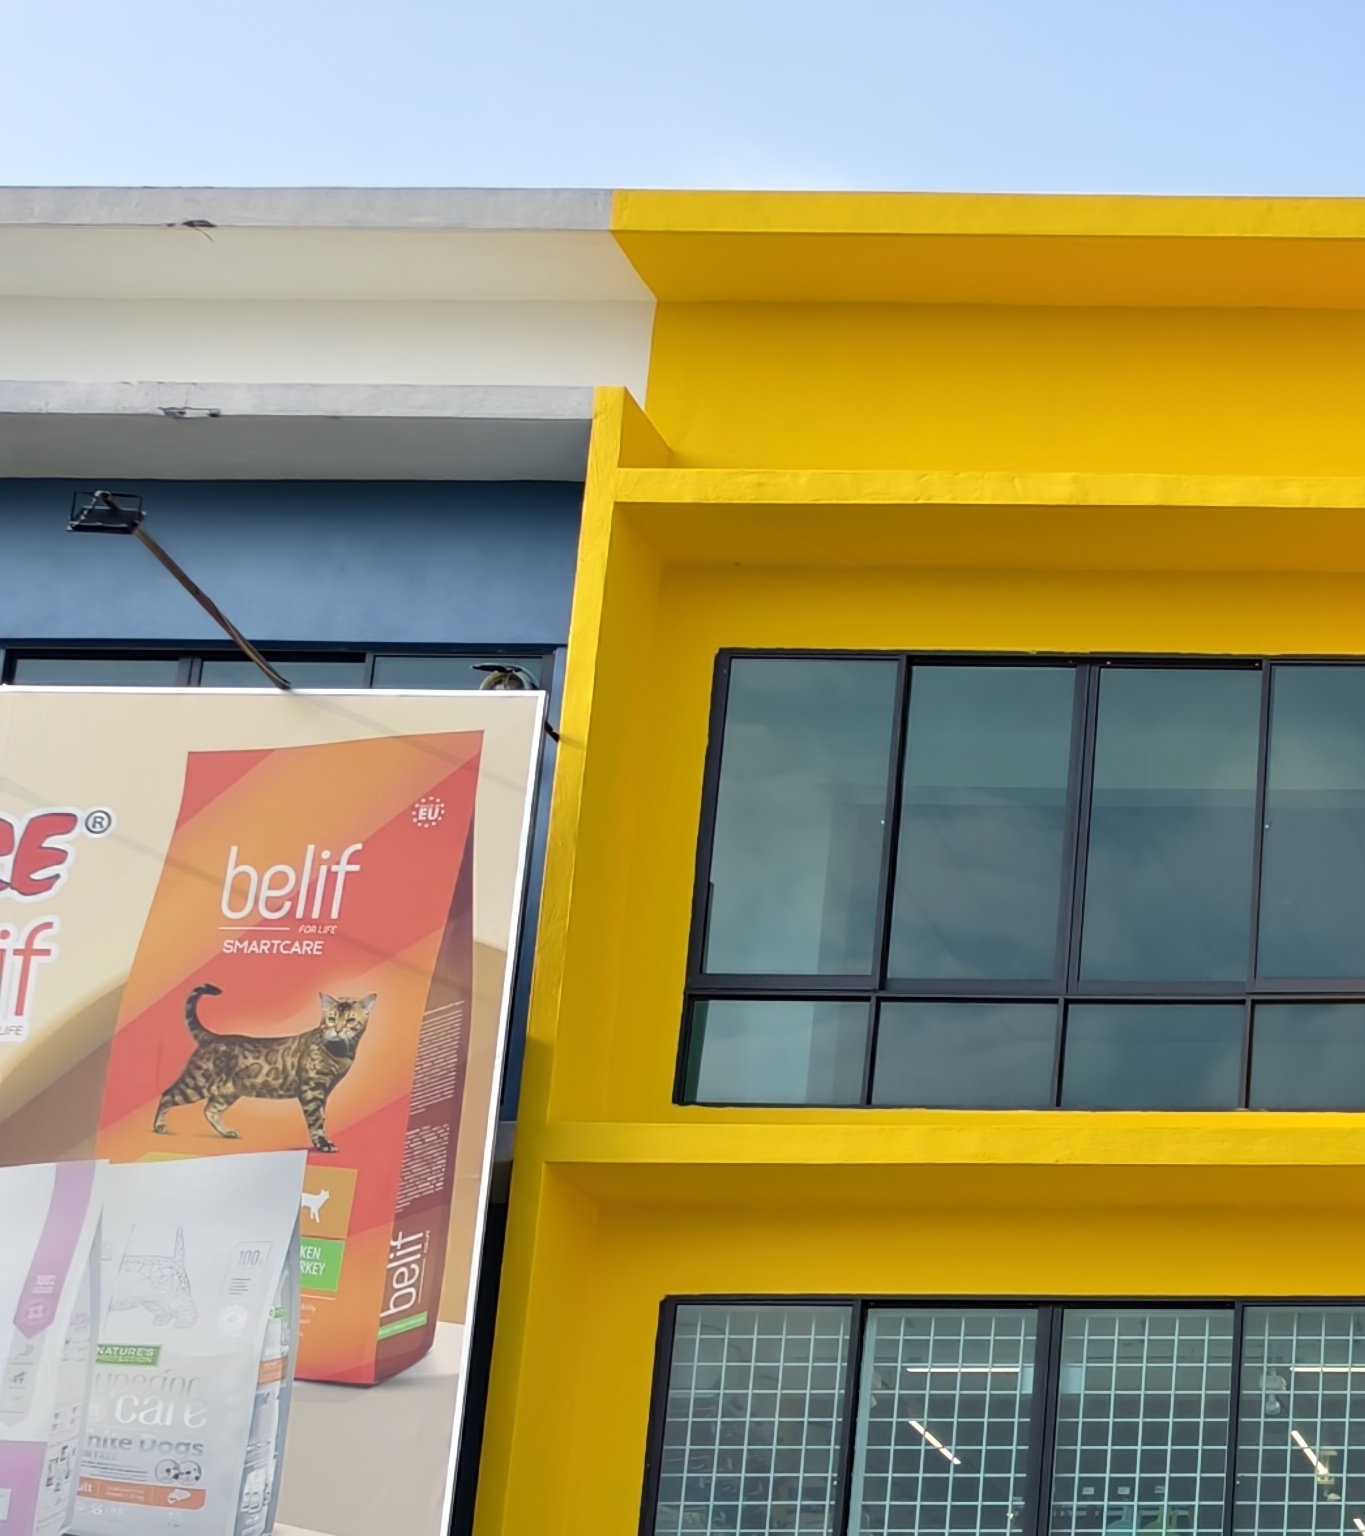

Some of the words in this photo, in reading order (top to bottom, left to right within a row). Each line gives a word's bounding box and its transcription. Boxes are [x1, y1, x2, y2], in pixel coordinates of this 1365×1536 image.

[221, 843, 363, 920] belif
[222, 939, 325, 955] SMARTCARE
[318, 925, 338, 935] LIFE
[380, 1231, 424, 1318] belif
[115, 1394, 207, 1429] care
